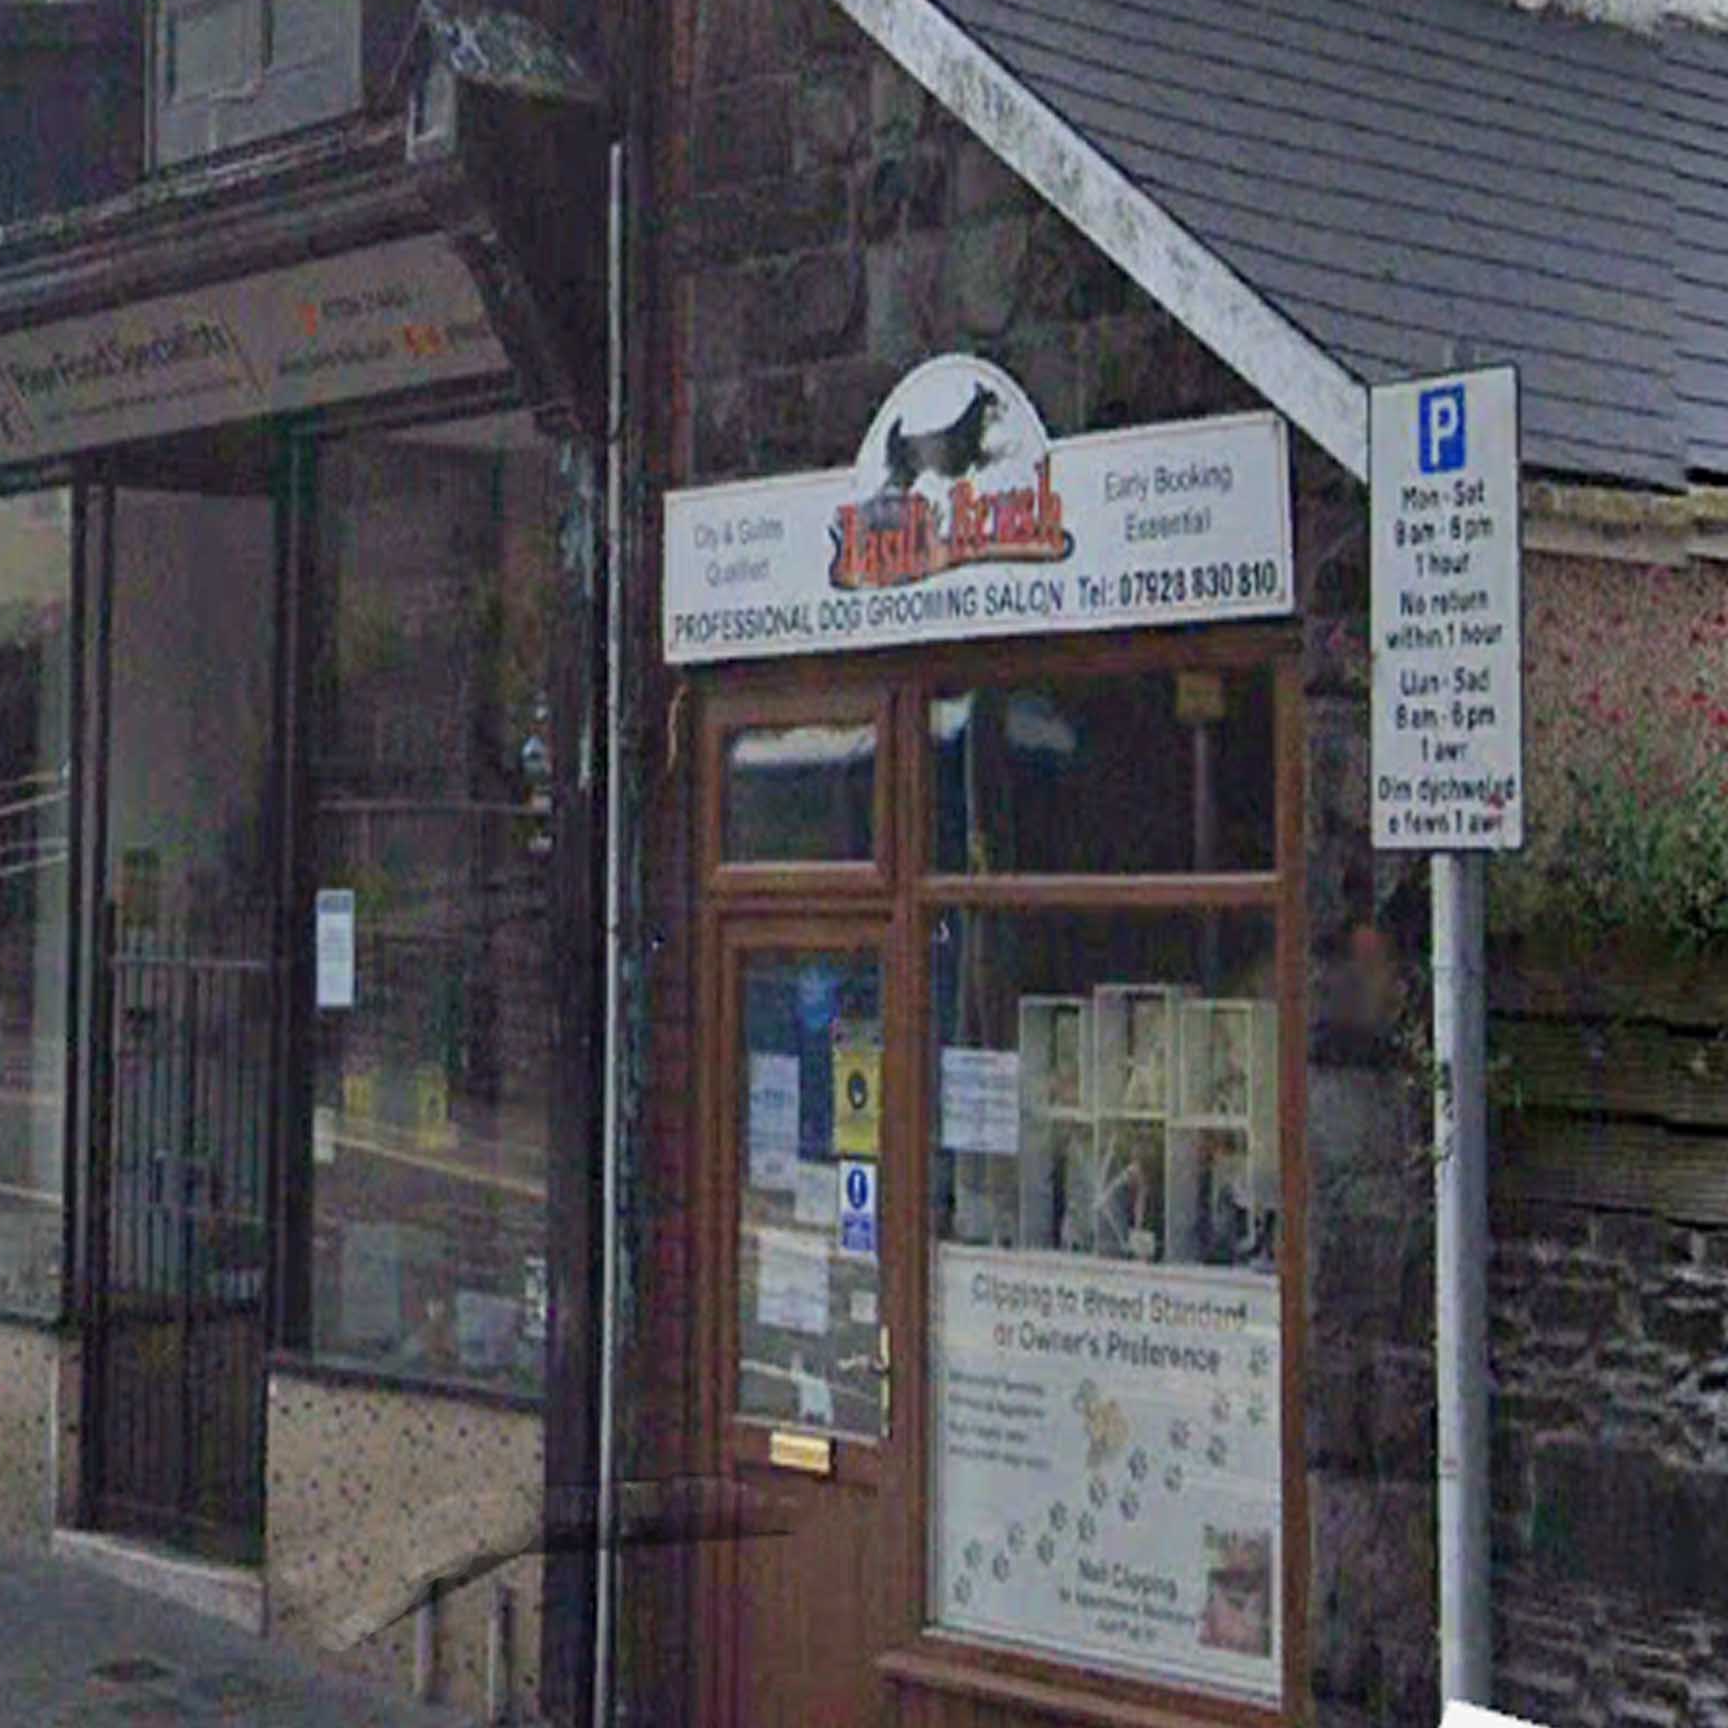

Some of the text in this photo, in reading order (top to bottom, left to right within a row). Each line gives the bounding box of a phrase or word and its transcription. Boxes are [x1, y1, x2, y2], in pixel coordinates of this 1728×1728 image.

[1430, 396, 1459, 466] P
[1104, 462, 1234, 503] Early Booking
[1401, 485, 1439, 511] Mon
[1453, 477, 1485, 508] Sat
[1428, 551, 1471, 575] hour
[673, 602, 814, 645] PROFESSIONAL
[818, 597, 862, 636] DOG
[866, 585, 978, 627] GROOMING
[985, 579, 1065, 618] SALON
[1077, 574, 1114, 610] Tel:
[1400, 589, 1489, 617] No return
[1386, 624, 1444, 650] within
[1460, 622, 1503, 647] hour
[1453, 665, 1490, 695] Sad
[1434, 742, 1469, 763] awr
[1377, 774, 1413, 802] Dim
